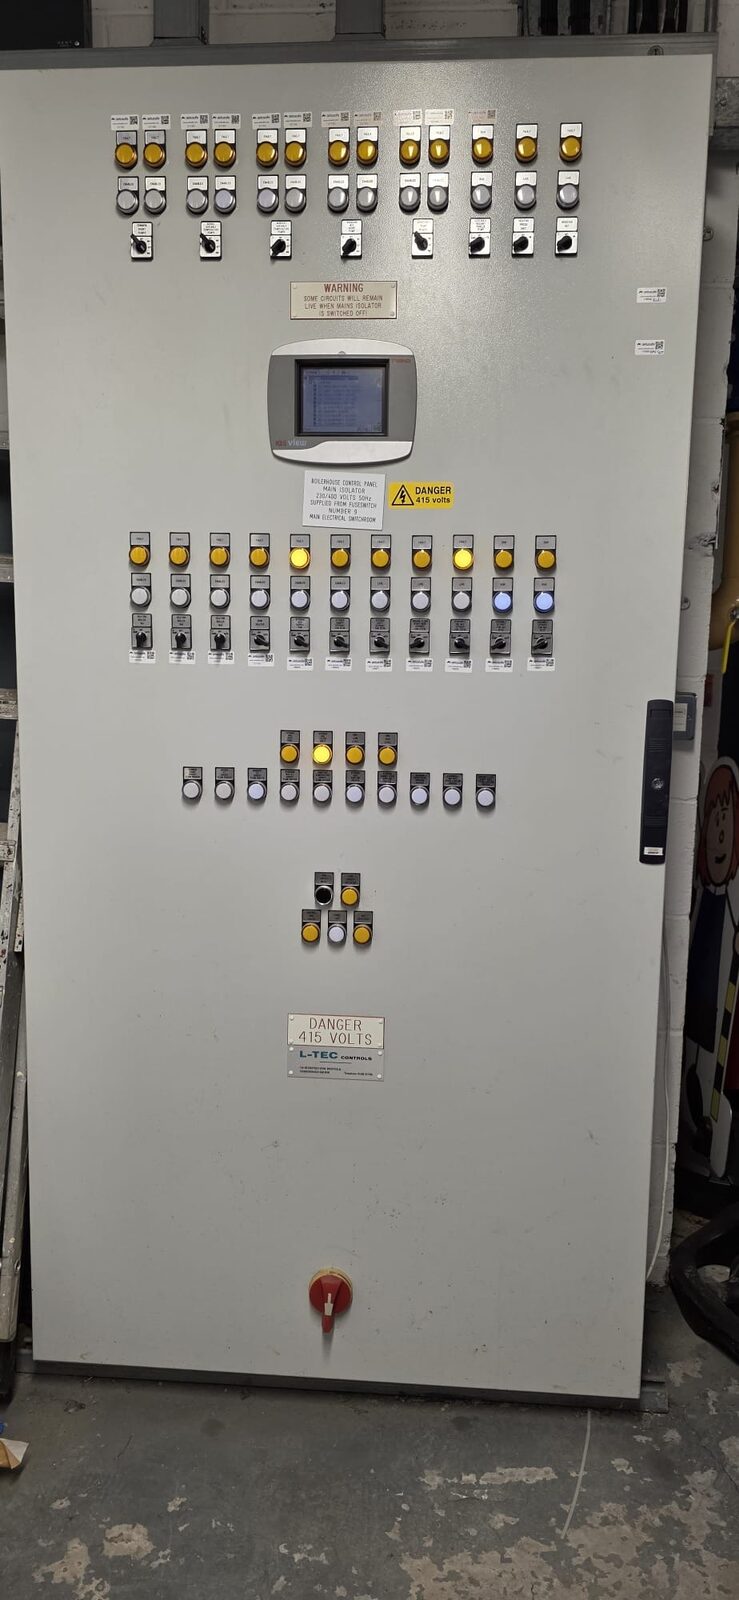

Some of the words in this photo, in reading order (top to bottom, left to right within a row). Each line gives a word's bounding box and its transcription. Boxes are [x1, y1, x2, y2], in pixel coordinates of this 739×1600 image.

[323, 283, 364, 293] WARNING
[311, 478, 341, 486] BOILERHOUSE
[342, 479, 361, 487] CONTROL
[363, 480, 378, 488] PANEL
[415, 486, 452, 495] DANGER
[415, 496, 430, 504] 415
[432, 496, 451, 504] volts
[328, 507, 351, 515] NUMBER
[321, 514, 347, 522] ELECTRICAL
[309, 1017, 362, 1031] DANGER
[298, 1031, 322, 1043] 415
[329, 1032, 372, 1045] VOLTS
[299, 1051, 338, 1060] L-TEC
